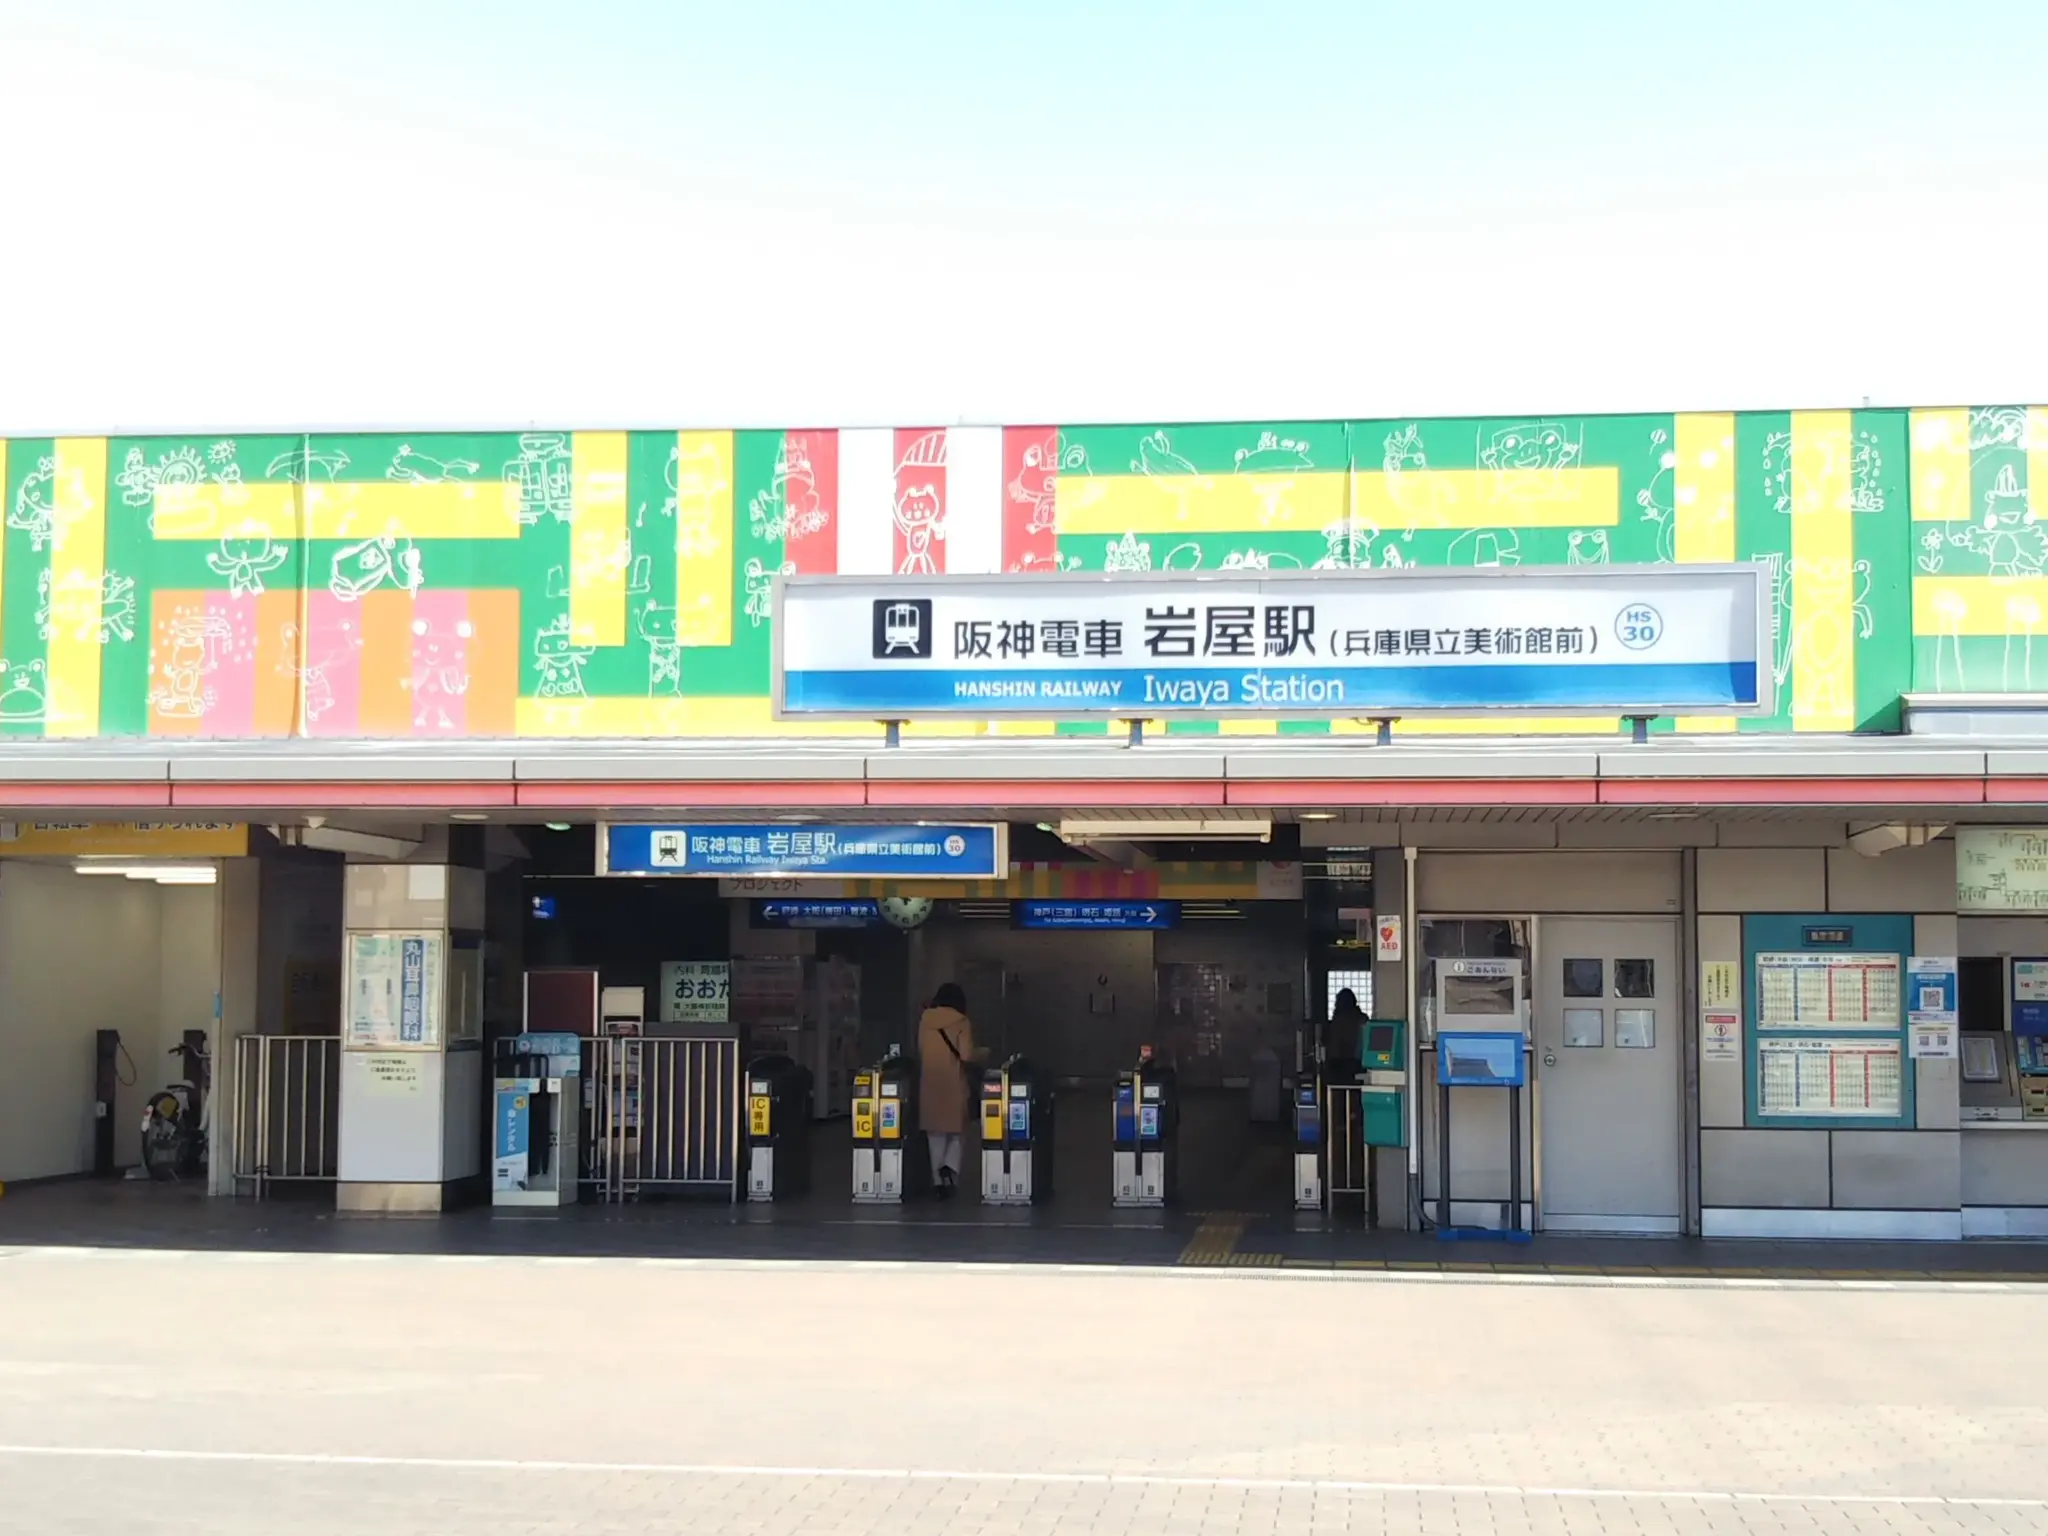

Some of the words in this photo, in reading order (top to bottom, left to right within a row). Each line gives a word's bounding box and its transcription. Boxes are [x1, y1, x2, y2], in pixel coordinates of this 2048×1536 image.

[1626, 611, 1652, 623] HS
[953, 620, 1123, 659] 阪神電車
[1144, 605, 1316, 657] 岩屋駅
[1623, 626, 1654, 642] 30
[954, 681, 1036, 698] HANSHIN
[1040, 680, 1123, 697] RAILWAY
[1143, 674, 1230, 703] Iwaya
[1240, 671, 1345, 702] Station
[691, 836, 761, 854] 阪神電車
[766, 831, 837, 855] 岩屋駅
[949, 844, 961, 853] 30
[706, 853, 744, 865] Hanshin
[745, 854, 780, 866] Railway
[1380, 942, 1398, 950] AED
[751, 1098, 766, 1110] IC
[856, 1120, 871, 1132] IC
